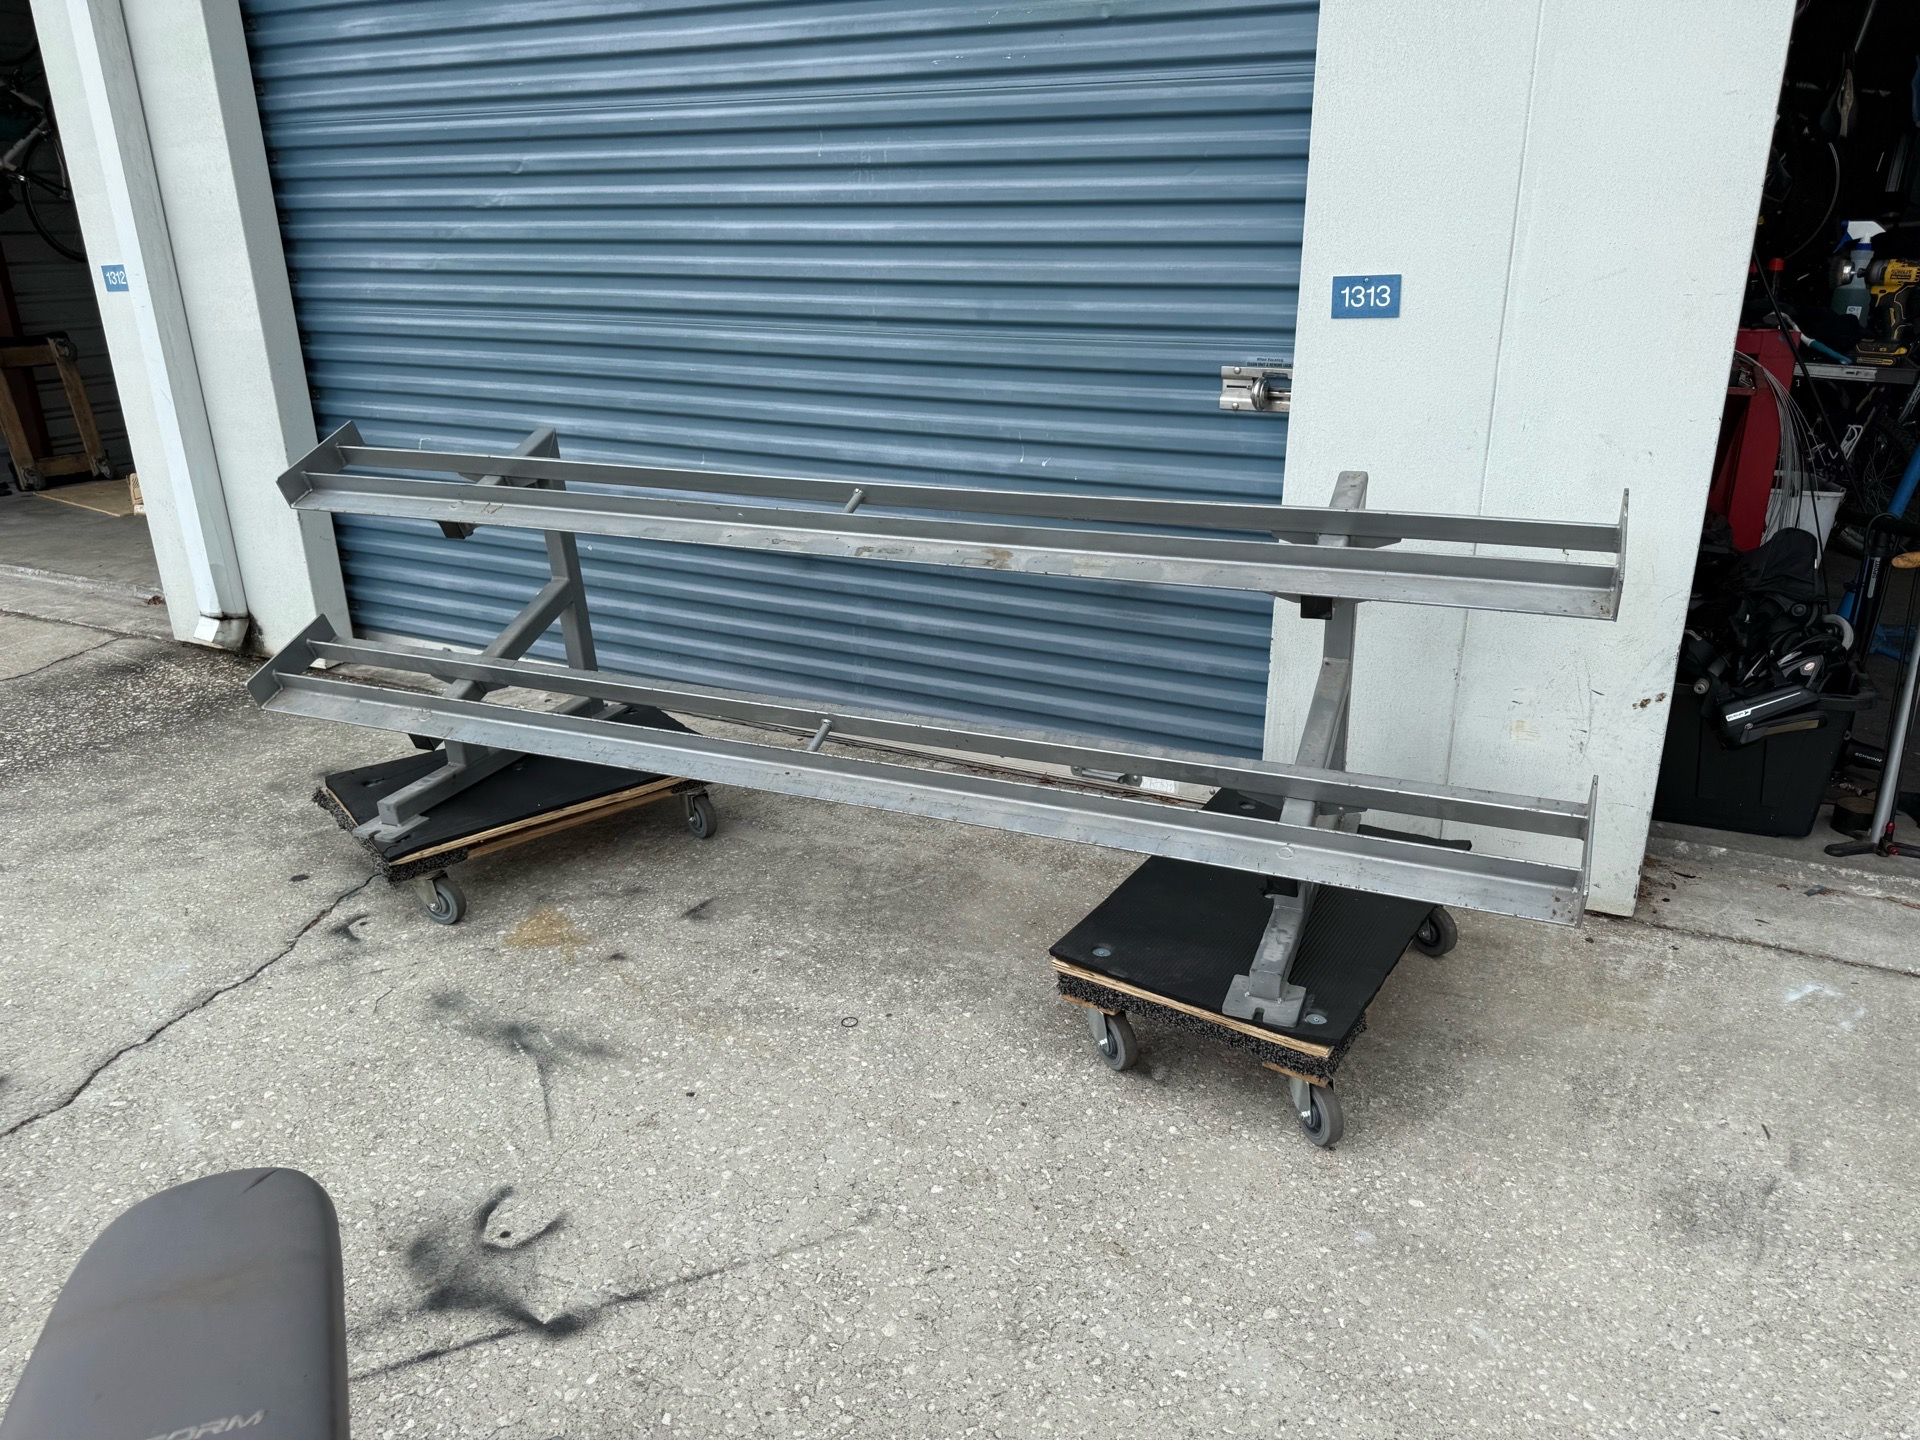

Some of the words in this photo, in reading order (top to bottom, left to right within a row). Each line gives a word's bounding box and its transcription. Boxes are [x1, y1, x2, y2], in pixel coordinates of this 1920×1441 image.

[105, 271, 127, 285] 1312
[1340, 284, 1391, 308] 1313
[146, 1410, 266, 1440] ORM
